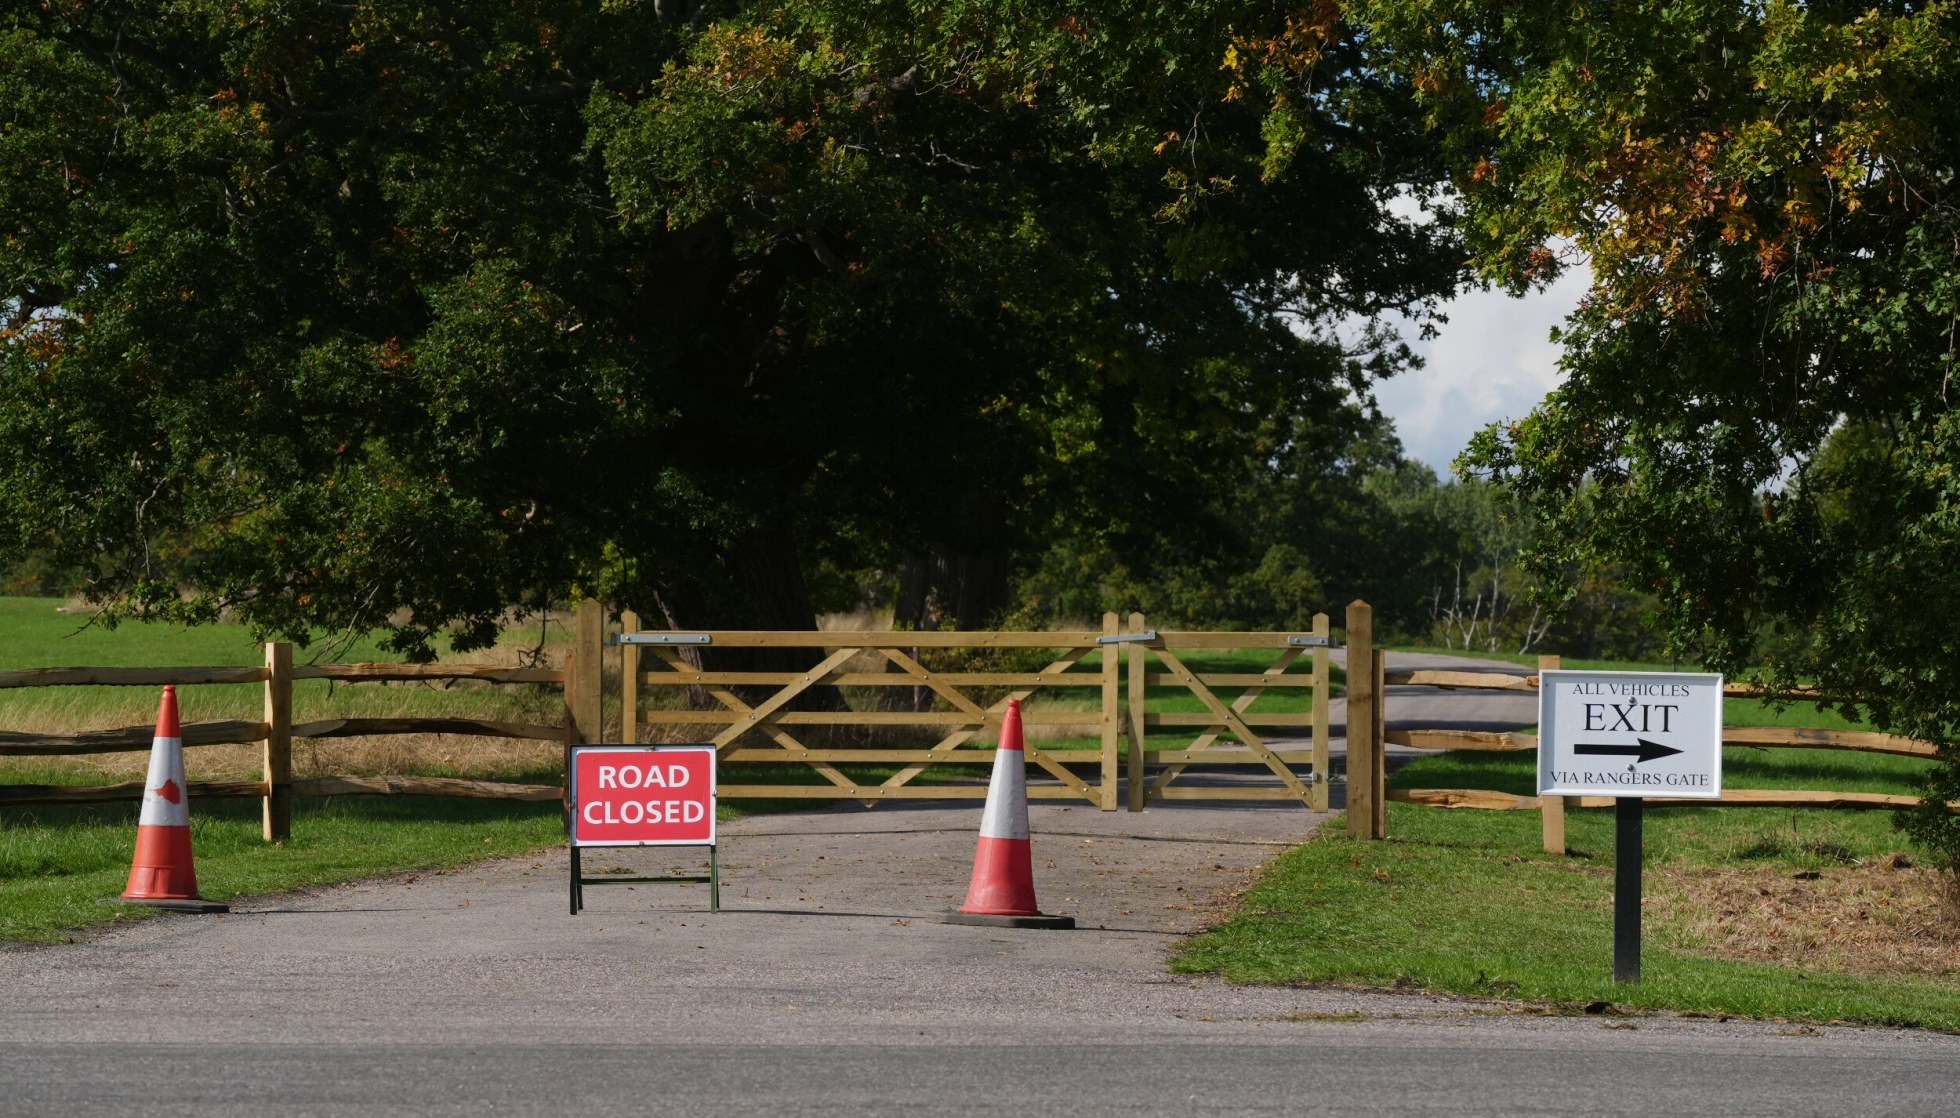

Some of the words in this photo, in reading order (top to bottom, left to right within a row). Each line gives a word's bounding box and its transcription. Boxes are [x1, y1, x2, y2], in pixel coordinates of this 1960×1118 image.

[1572, 683, 1605, 696] ALL
[1609, 683, 1690, 697] VEHICLES
[1582, 703, 1679, 733] EXIT
[598, 765, 690, 789] ROAD
[1550, 771, 1579, 784] VIA
[1584, 771, 1662, 786] RANGERS
[1666, 773, 1709, 787] GATE
[583, 800, 705, 825] CLOSED
